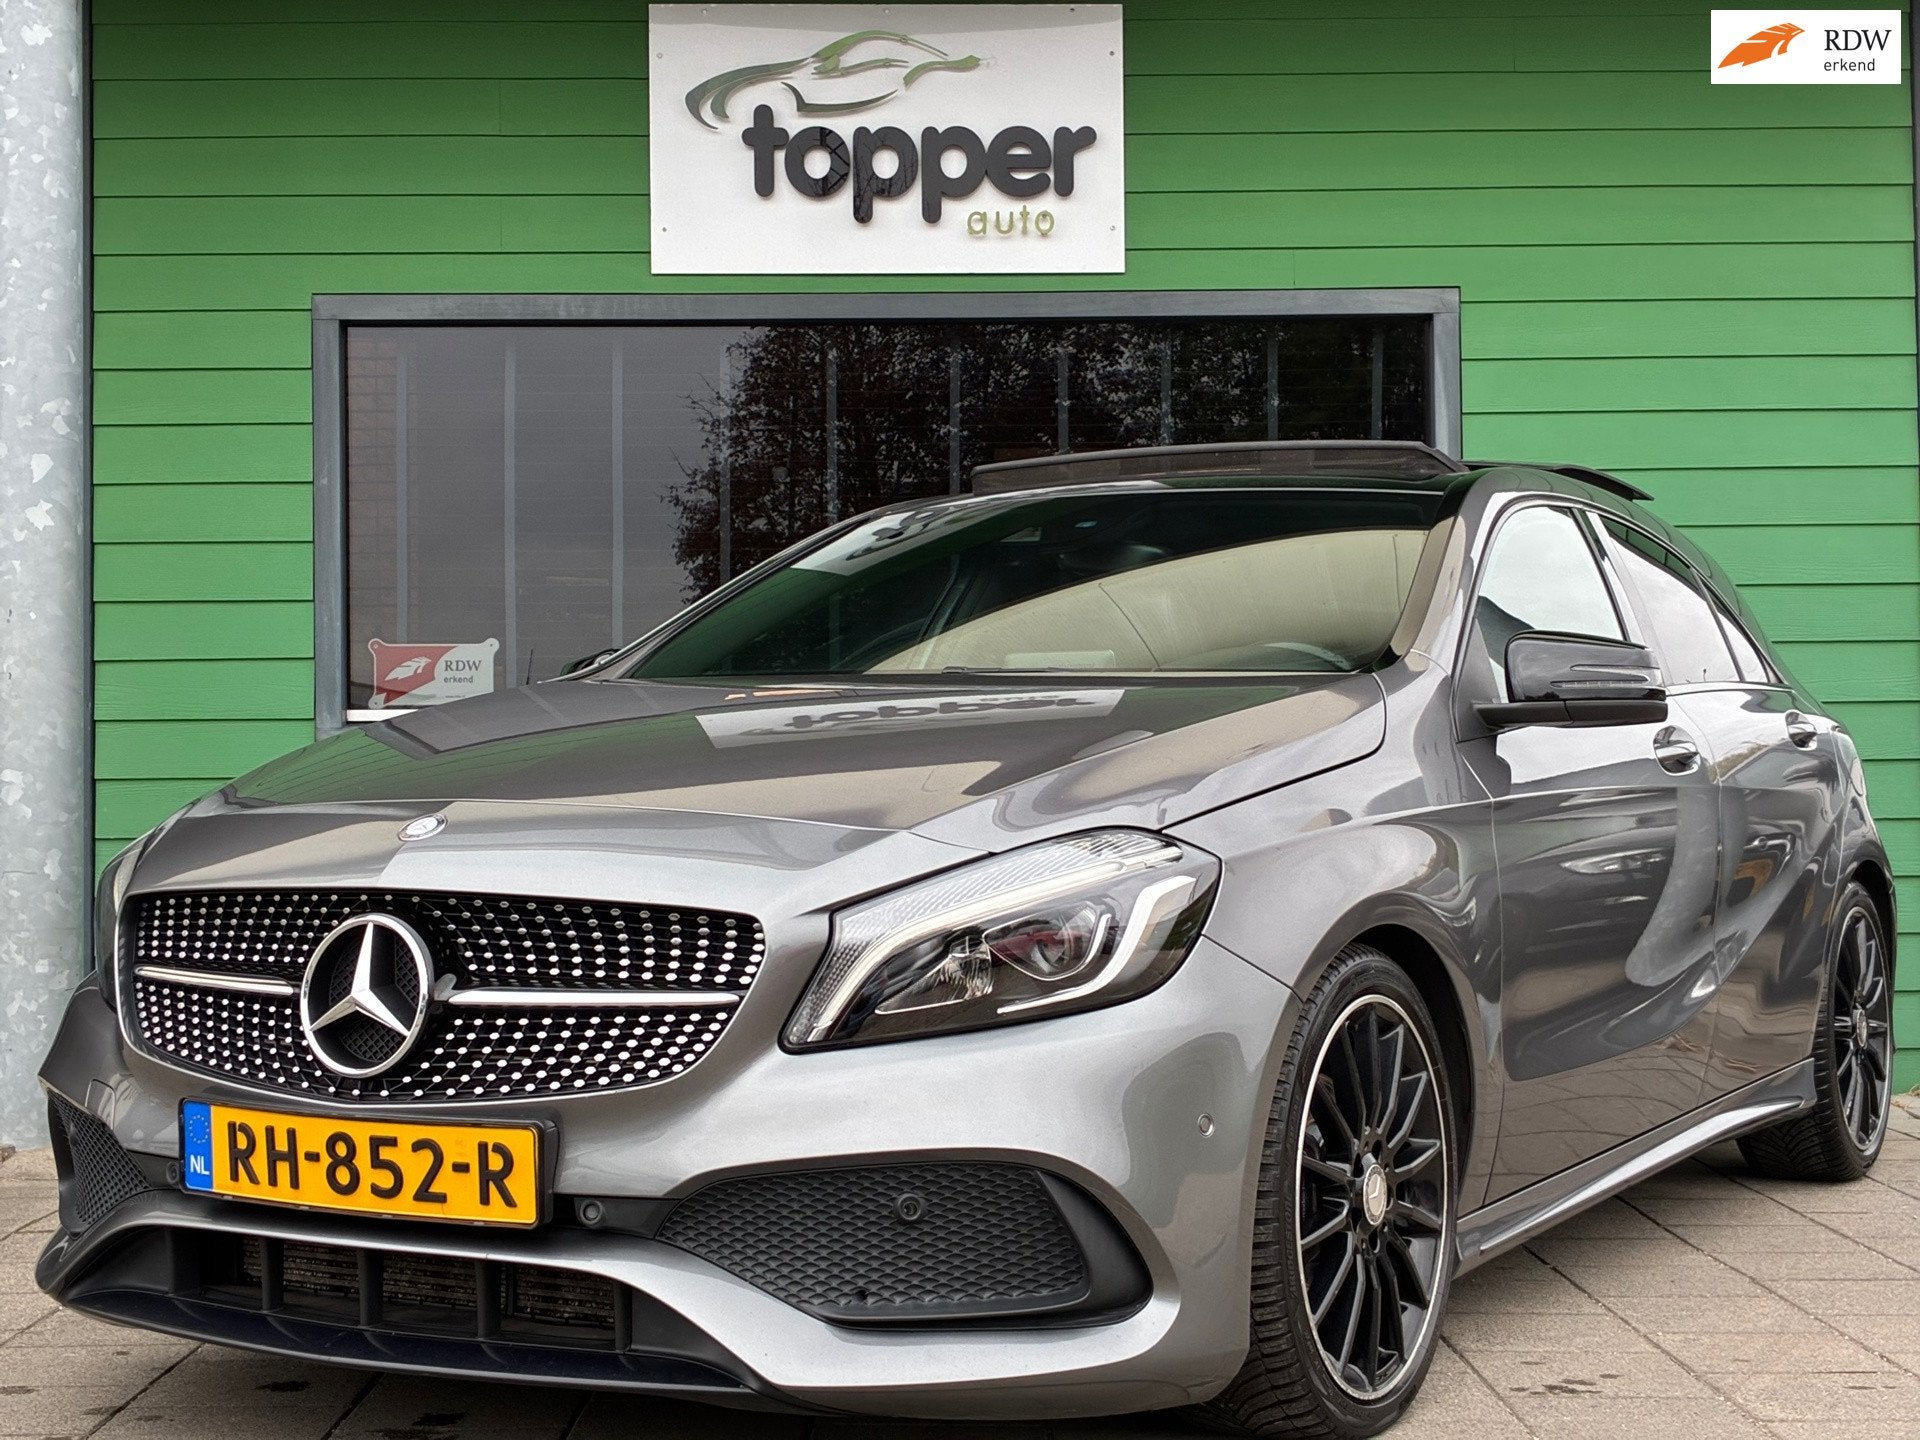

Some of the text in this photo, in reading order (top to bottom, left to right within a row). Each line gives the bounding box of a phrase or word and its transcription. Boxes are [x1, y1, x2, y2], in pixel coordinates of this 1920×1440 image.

[741, 104, 1097, 224] topper
[967, 205, 1055, 235] auto
[444, 660, 482, 671] RDW
[444, 675, 473, 683] erkend
[190, 1155, 210, 1175] NL
[227, 1120, 518, 1208] RH-852-R
